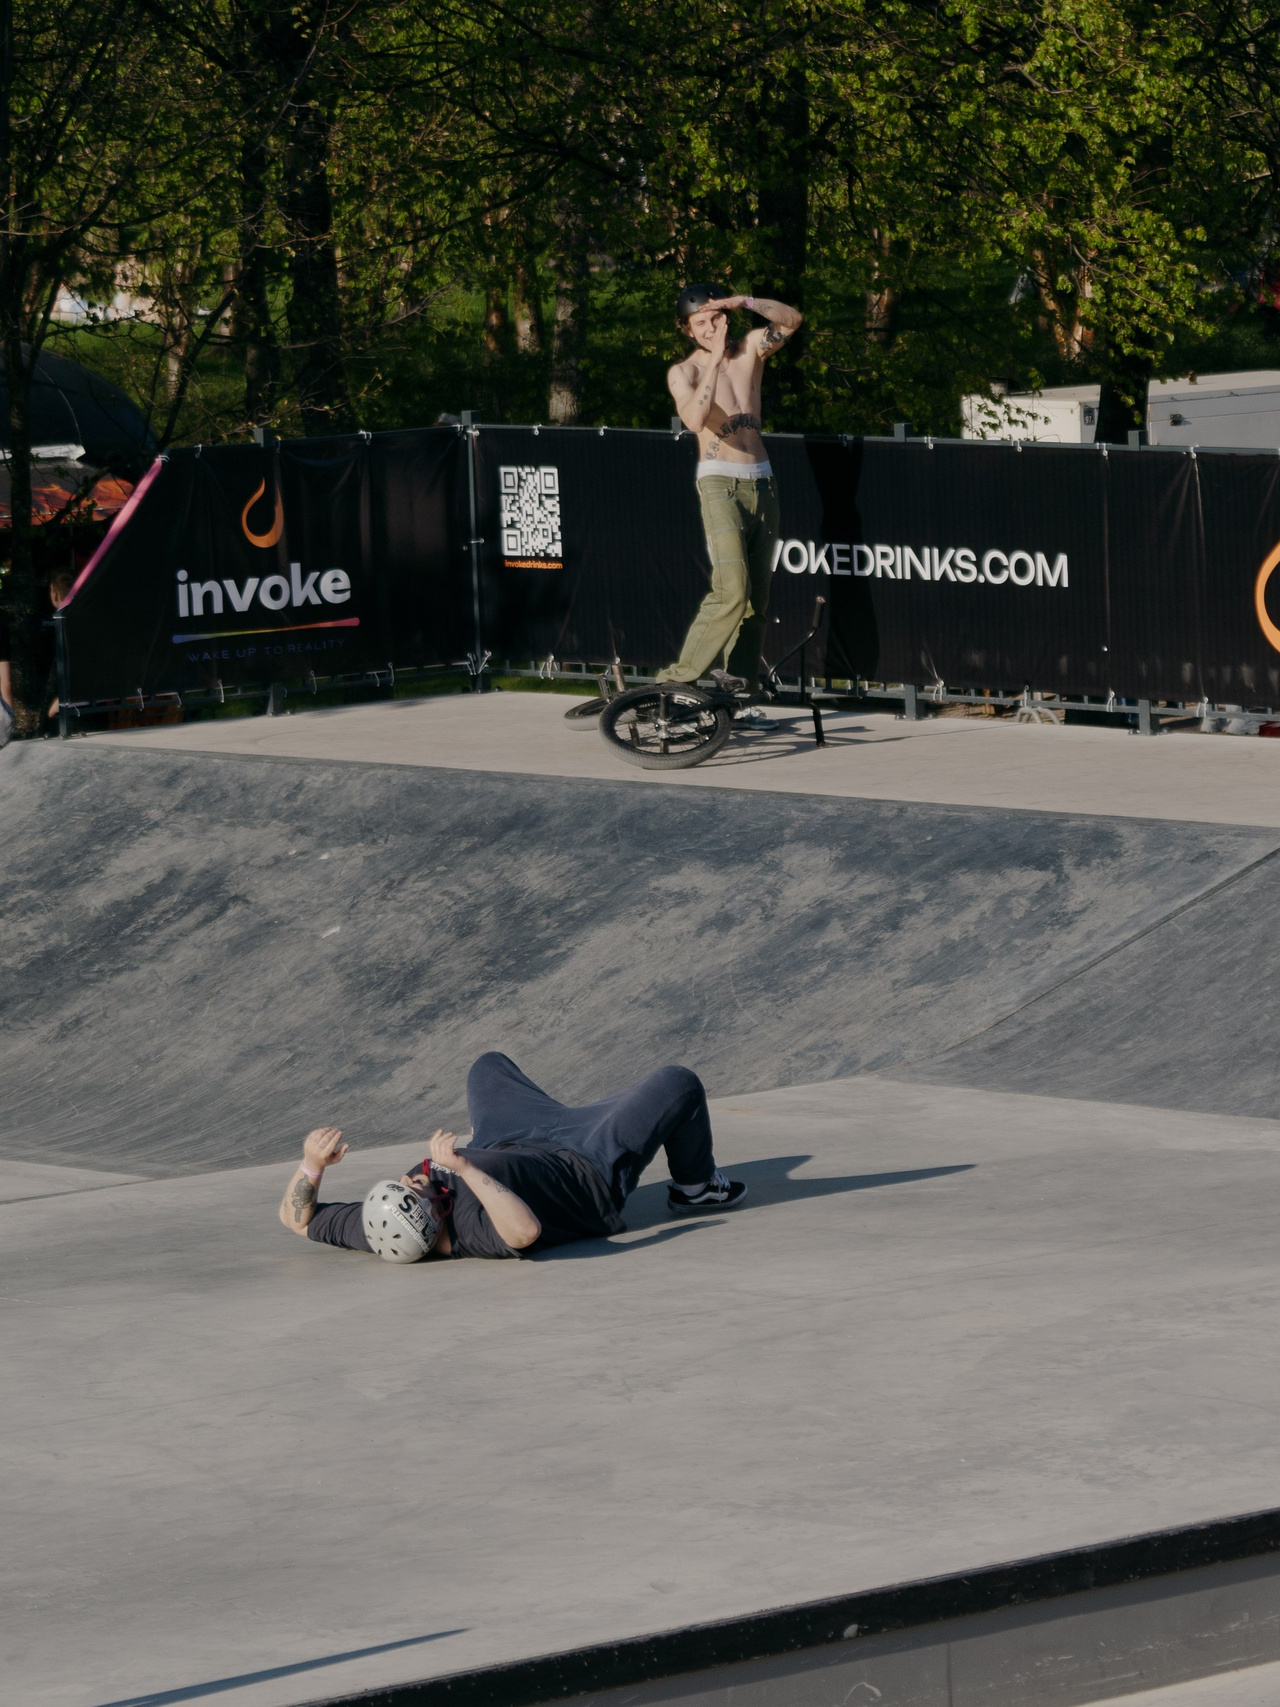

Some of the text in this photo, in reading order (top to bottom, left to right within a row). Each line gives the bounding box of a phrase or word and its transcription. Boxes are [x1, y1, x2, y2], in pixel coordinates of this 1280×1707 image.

[504, 559, 563, 570] invokedrinks.com
[176, 562, 352, 618] invoke
[188, 639, 346, 663] WAKE UP TO REALITY
